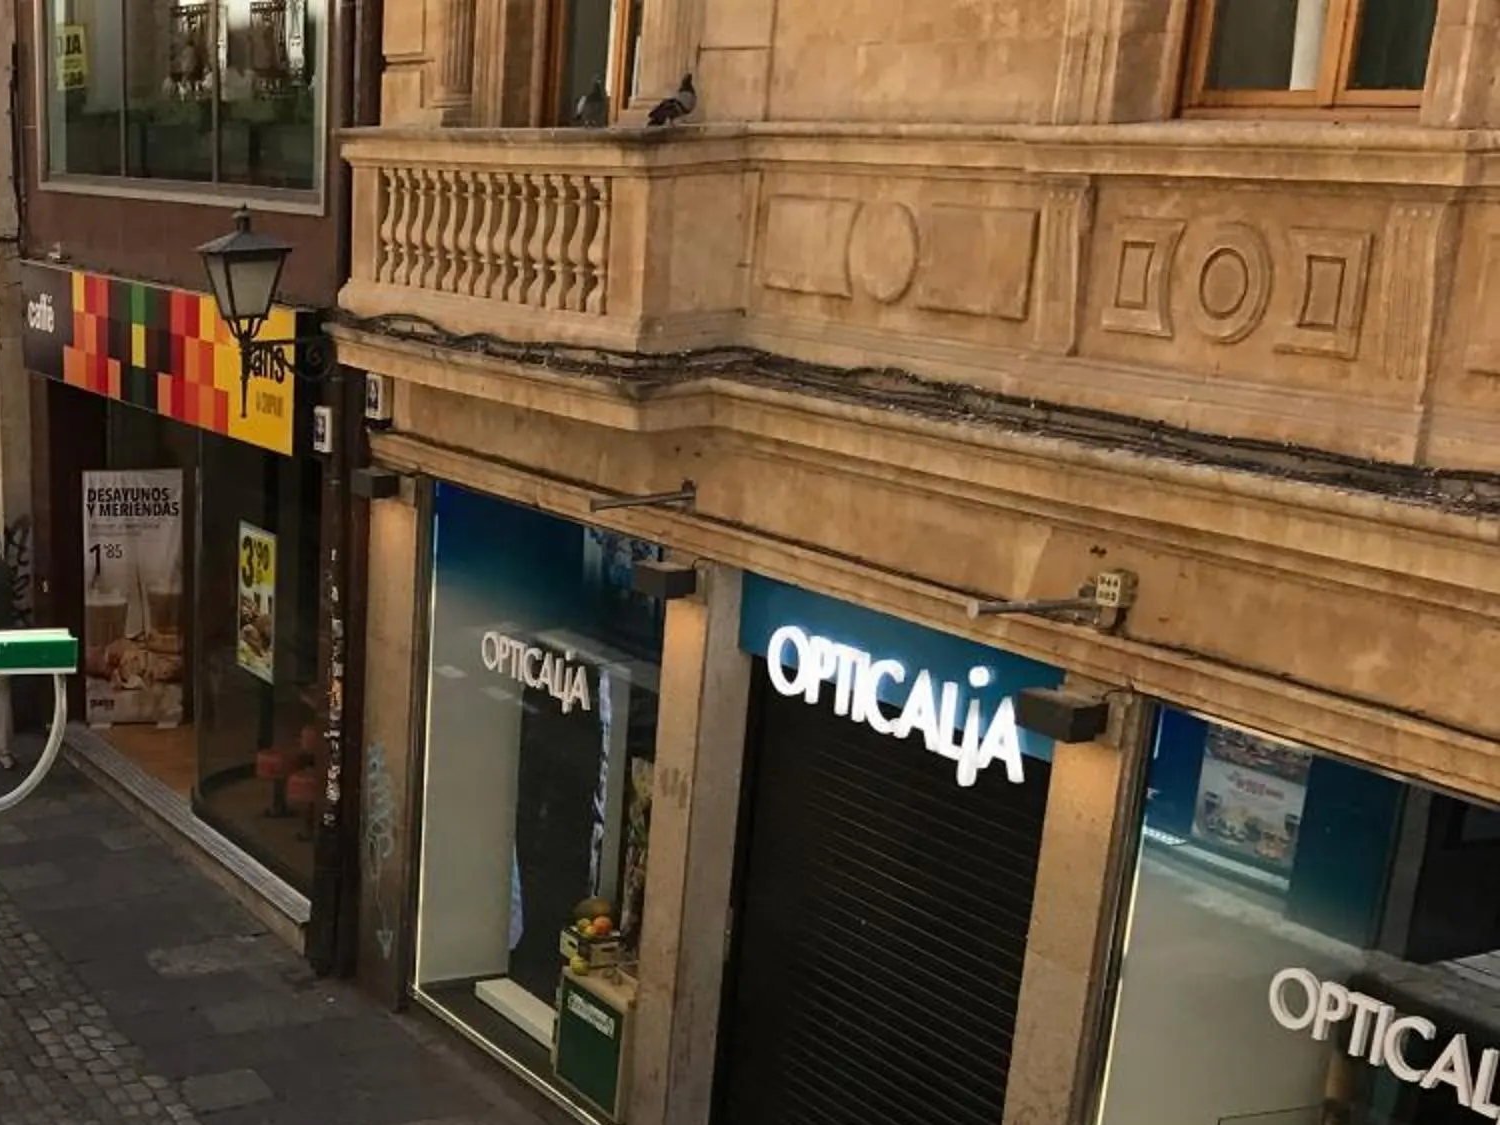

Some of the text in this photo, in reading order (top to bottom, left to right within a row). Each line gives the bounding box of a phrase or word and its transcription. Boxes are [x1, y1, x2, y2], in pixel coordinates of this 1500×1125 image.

[87, 487, 170, 503] DESAYUNOS
[87, 502, 180, 518] Y MERIENDAS
